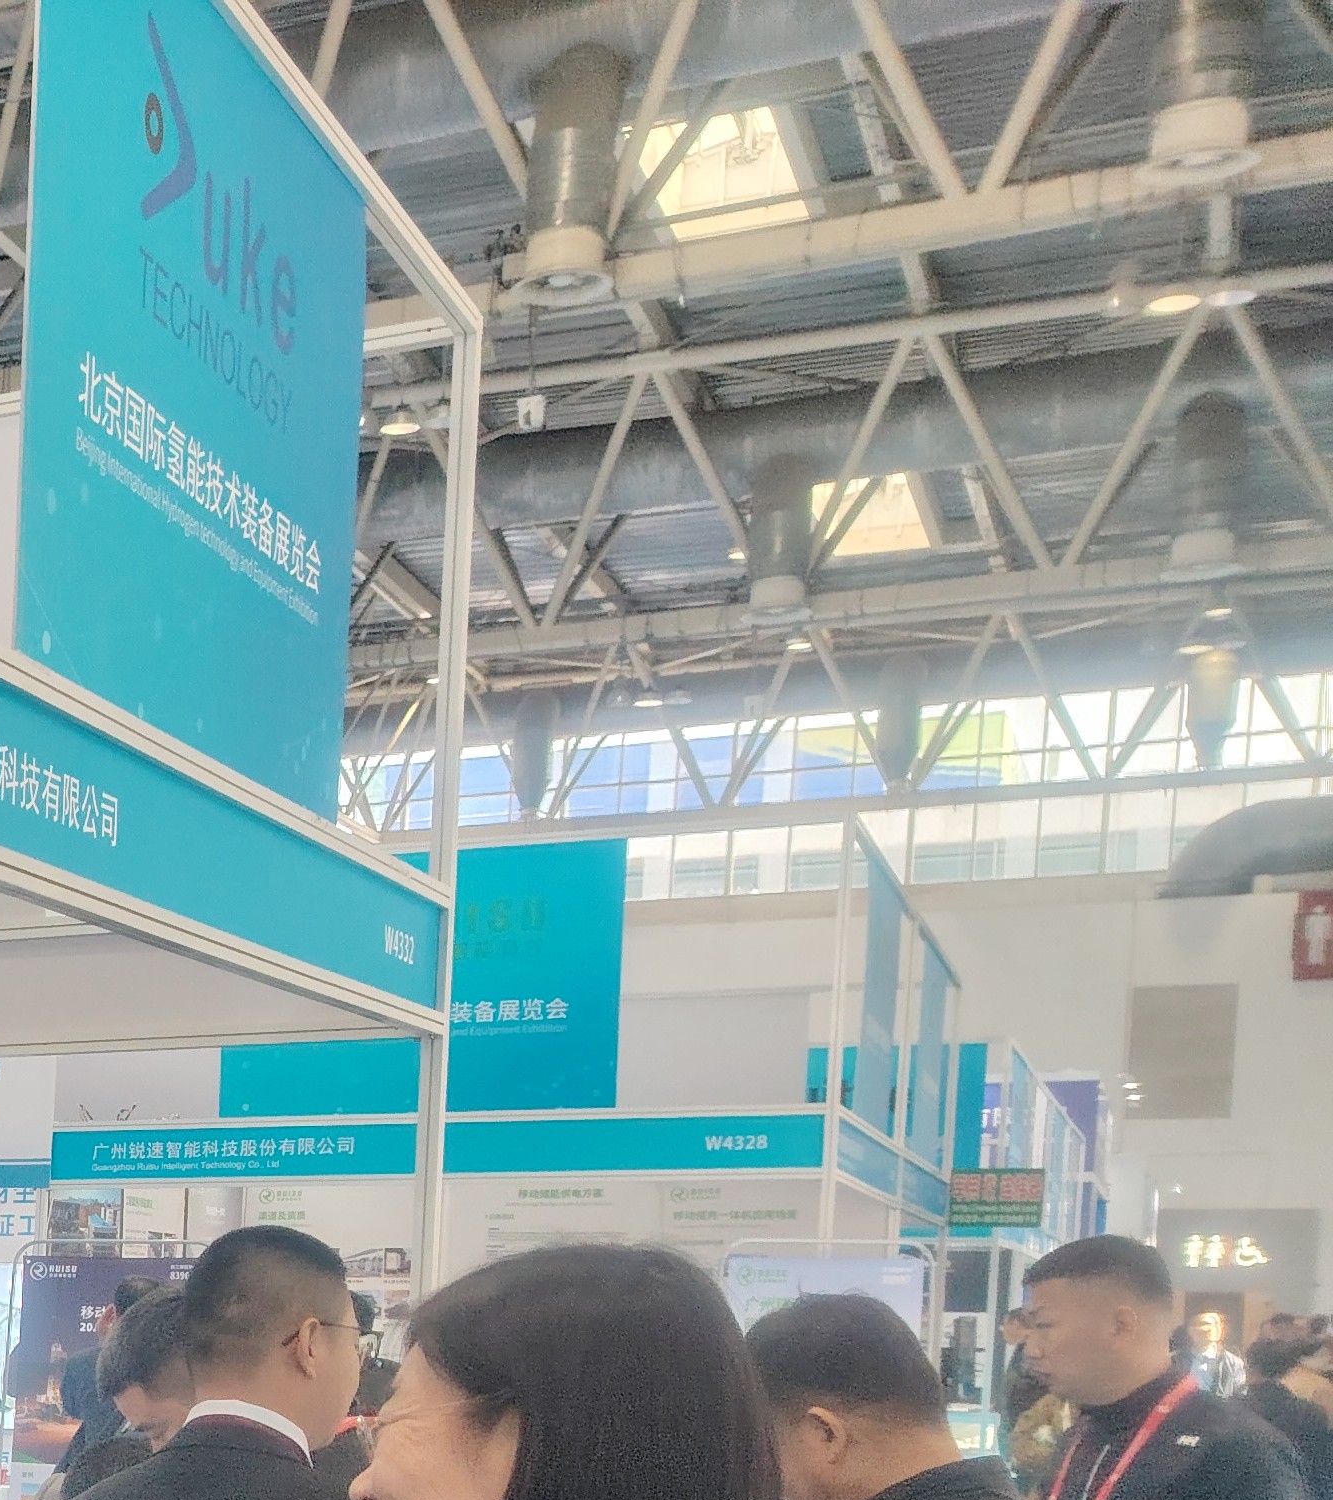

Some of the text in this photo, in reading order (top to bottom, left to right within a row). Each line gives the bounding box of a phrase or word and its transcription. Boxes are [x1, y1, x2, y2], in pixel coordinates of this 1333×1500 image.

[139, 247, 293, 434] TECHNOLOGY
[78, 351, 321, 594] 北京国际氢能技术装备展览会
[384, 923, 415, 965] W4332
[450, 998, 570, 1024] 装备展览会
[91, 1136, 355, 1160] 广州锐速智能科技股份有限公司
[705, 1134, 768, 1151] W4328
